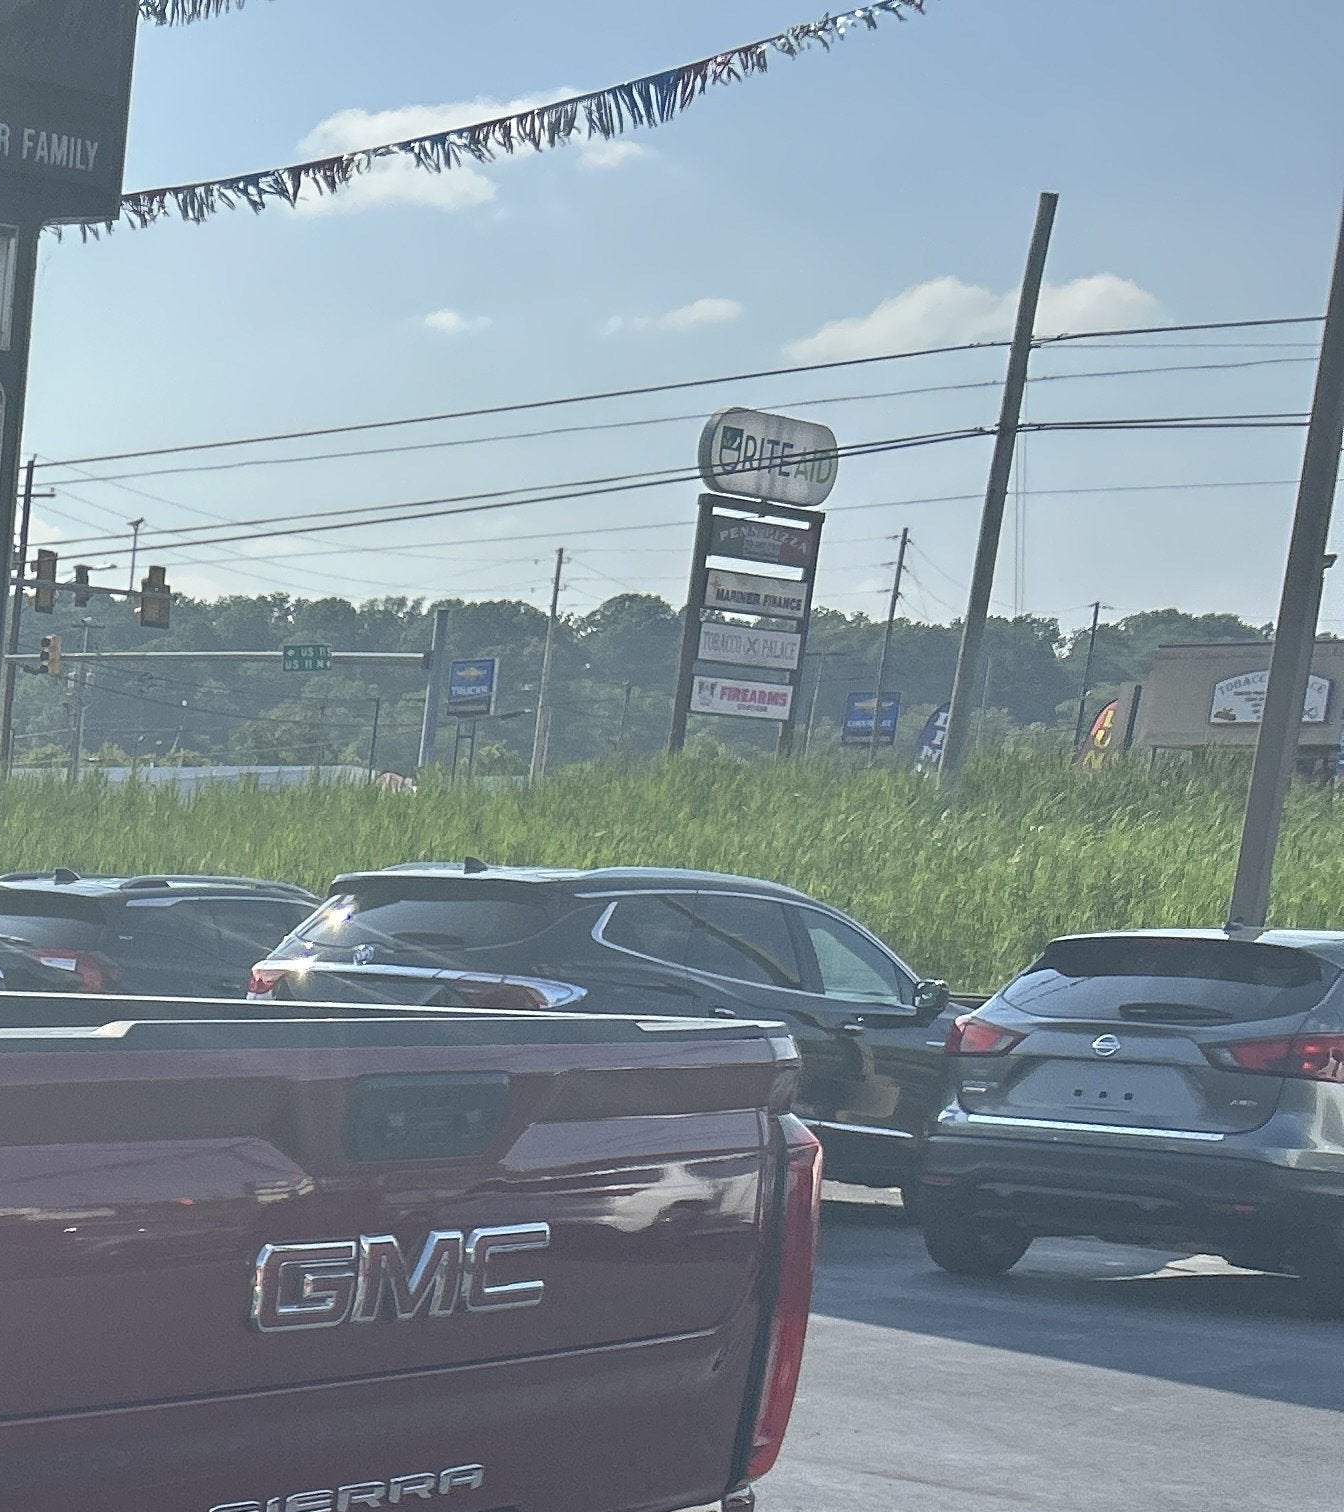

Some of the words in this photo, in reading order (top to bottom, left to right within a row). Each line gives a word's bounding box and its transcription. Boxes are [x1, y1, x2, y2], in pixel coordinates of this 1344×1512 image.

[20, 127, 99, 172] FAMILY
[742, 435, 794, 477] RITE
[794, 447, 833, 484] AID
[719, 685, 788, 707] FIREARMS
[252, 1221, 550, 1333] GMC
